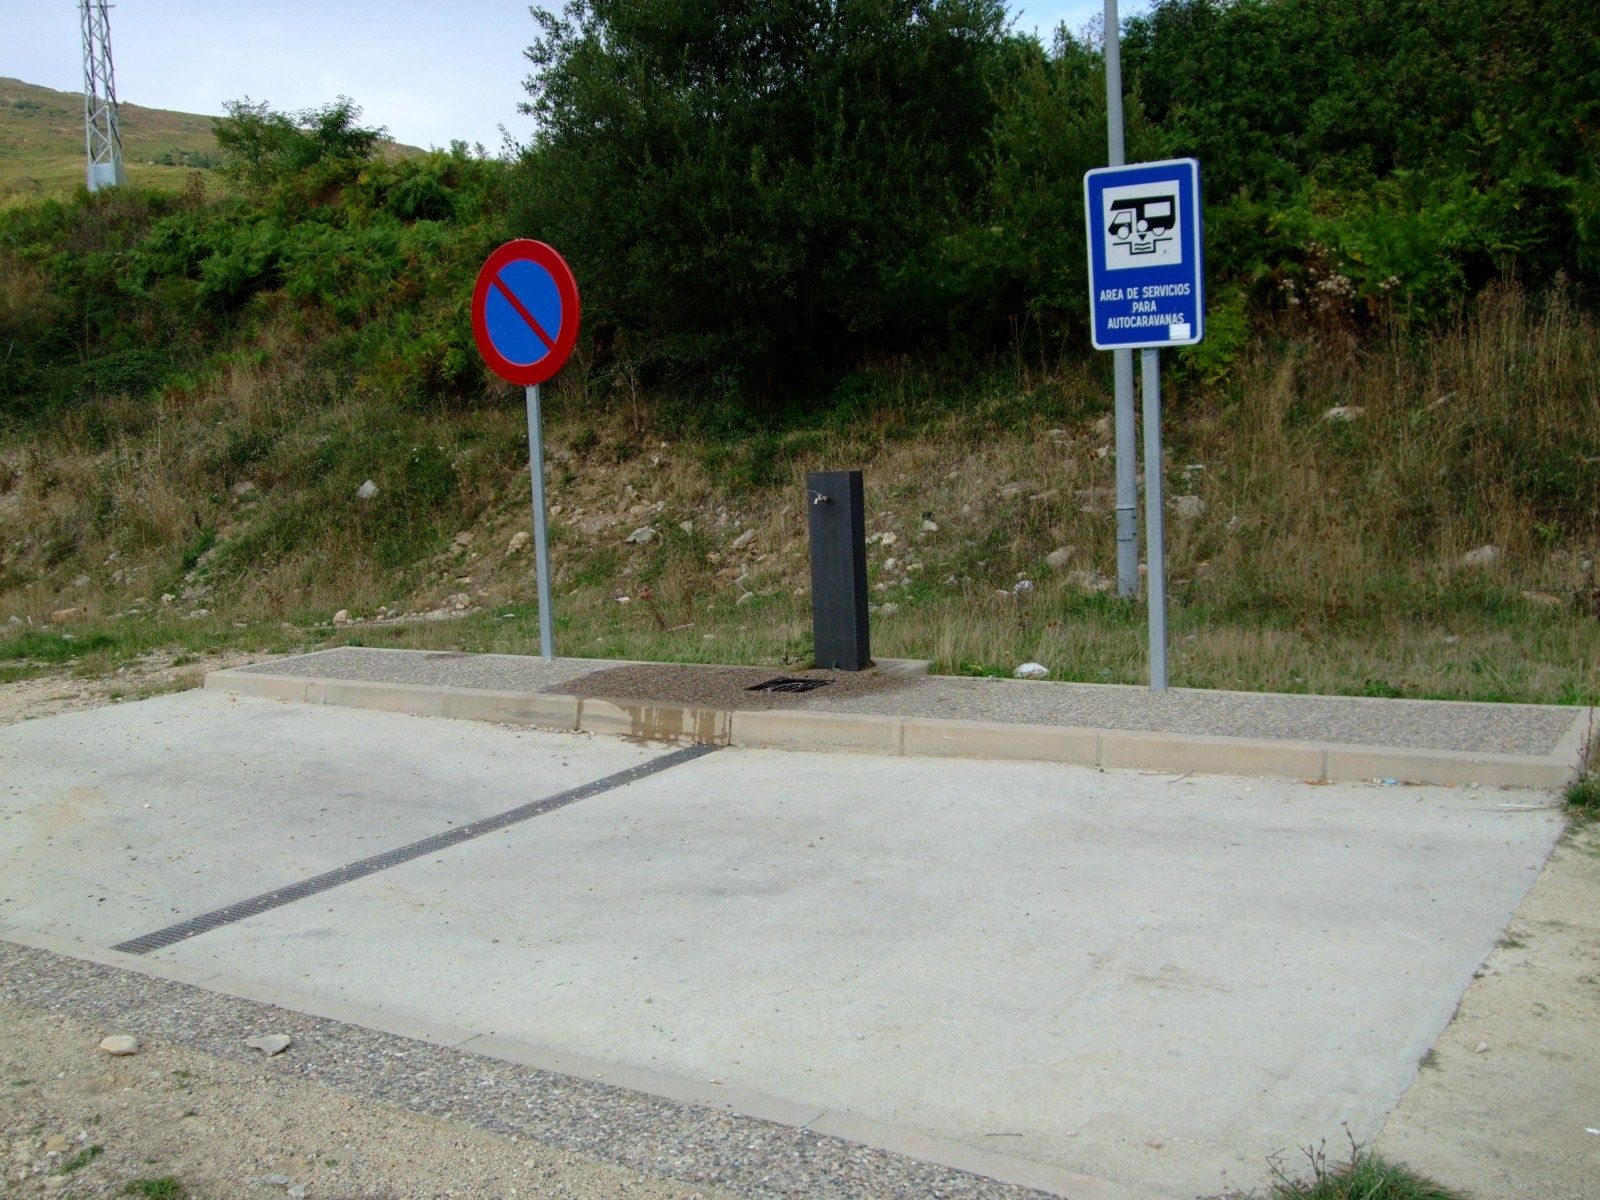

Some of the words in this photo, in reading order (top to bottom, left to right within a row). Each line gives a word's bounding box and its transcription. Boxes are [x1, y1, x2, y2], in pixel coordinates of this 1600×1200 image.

[1100, 289, 1123, 301] AREA
[1127, 287, 1139, 299] DE
[1142, 283, 1190, 298] SERVICIOS
[1132, 300, 1157, 313] PARA
[1107, 313, 1185, 329] AUTOCARAVANAS
